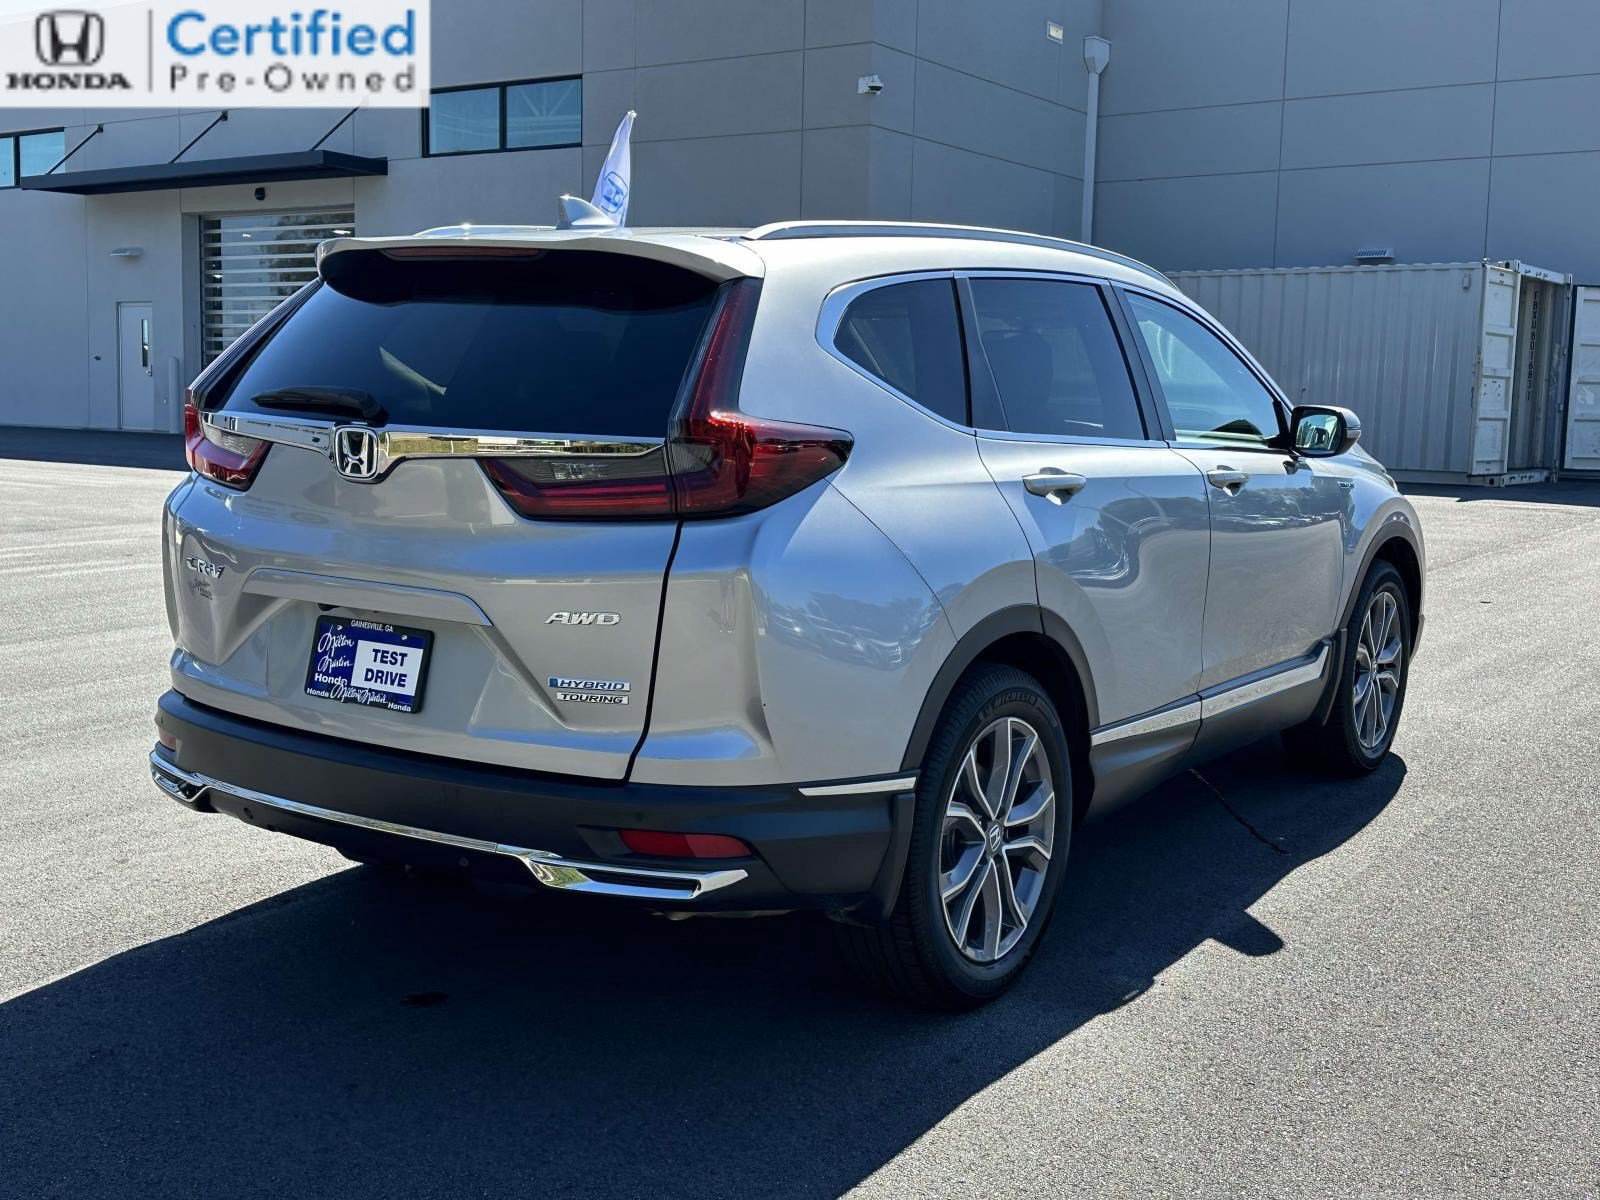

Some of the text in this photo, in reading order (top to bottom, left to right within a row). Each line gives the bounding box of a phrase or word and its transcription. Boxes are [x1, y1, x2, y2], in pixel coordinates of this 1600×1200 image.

[544, 611, 621, 626] AWD
[372, 649, 408, 667] TEST
[315, 673, 348, 686] Honda
[364, 668, 407, 688] DRIVE
[560, 680, 625, 690] HYBRID
[307, 688, 329, 697] Honda
[388, 703, 411, 712] Honda
[562, 693, 623, 703] TOURING
